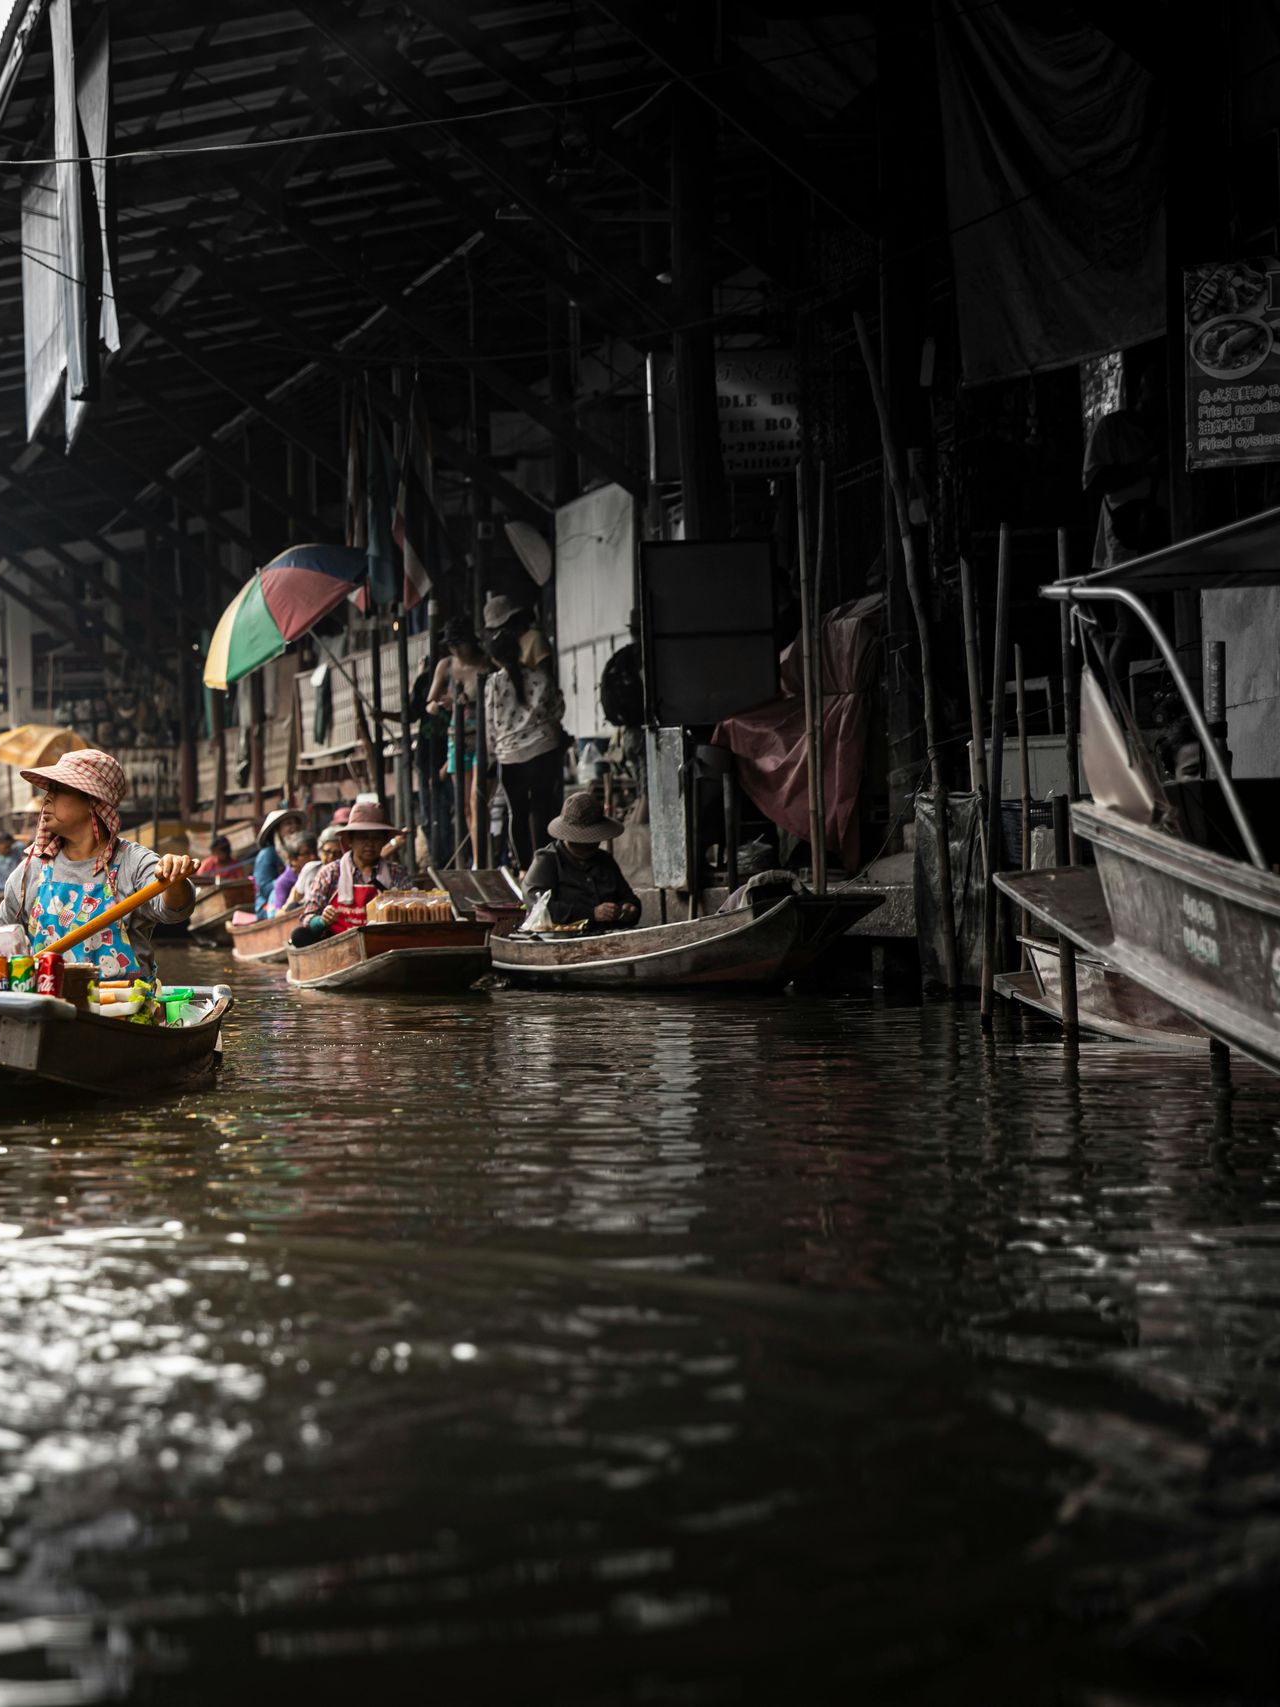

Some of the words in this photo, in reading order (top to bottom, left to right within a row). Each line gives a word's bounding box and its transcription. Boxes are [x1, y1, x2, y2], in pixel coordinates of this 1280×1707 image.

[1198, 403, 1232, 419] Fried
[1198, 435, 1232, 451] Fried
[1235, 433, 1280, 449] oysters
